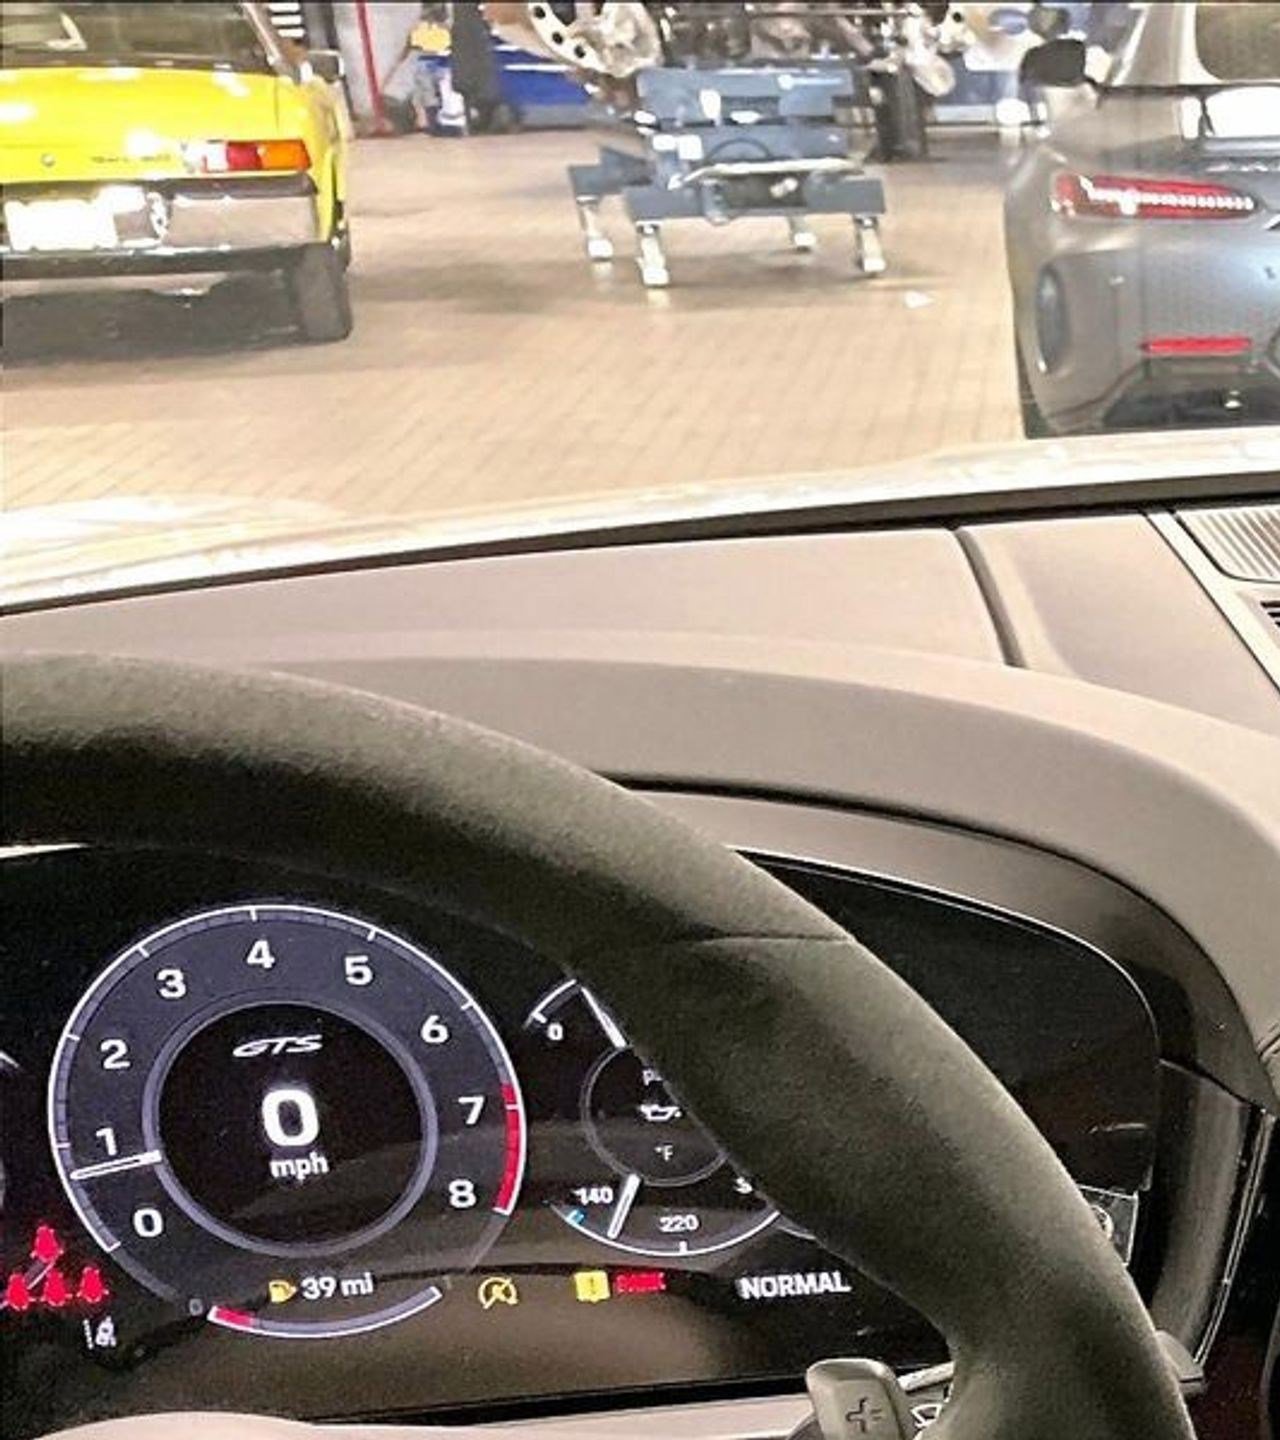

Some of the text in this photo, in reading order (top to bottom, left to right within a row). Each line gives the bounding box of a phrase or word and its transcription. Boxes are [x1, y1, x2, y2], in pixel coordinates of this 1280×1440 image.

[246, 940, 275, 968] 4
[157, 969, 187, 999] 3
[344, 955, 373, 986] 5
[421, 1015, 449, 1043] 6
[100, 1039, 130, 1069] 2
[233, 1035, 322, 1057] GTS
[261, 1089, 320, 1147] 0
[459, 1096, 484, 1124] 7
[96, 1128, 117, 1155] 1
[270, 1153, 329, 1181] mph
[448, 1180, 476, 1208] 8
[574, 1186, 613, 1204] 140
[133, 1208, 163, 1237] 0
[660, 1214, 699, 1232] 220
[301, 1272, 374, 1298] 39 mi
[736, 1271, 852, 1298] NORMAL
